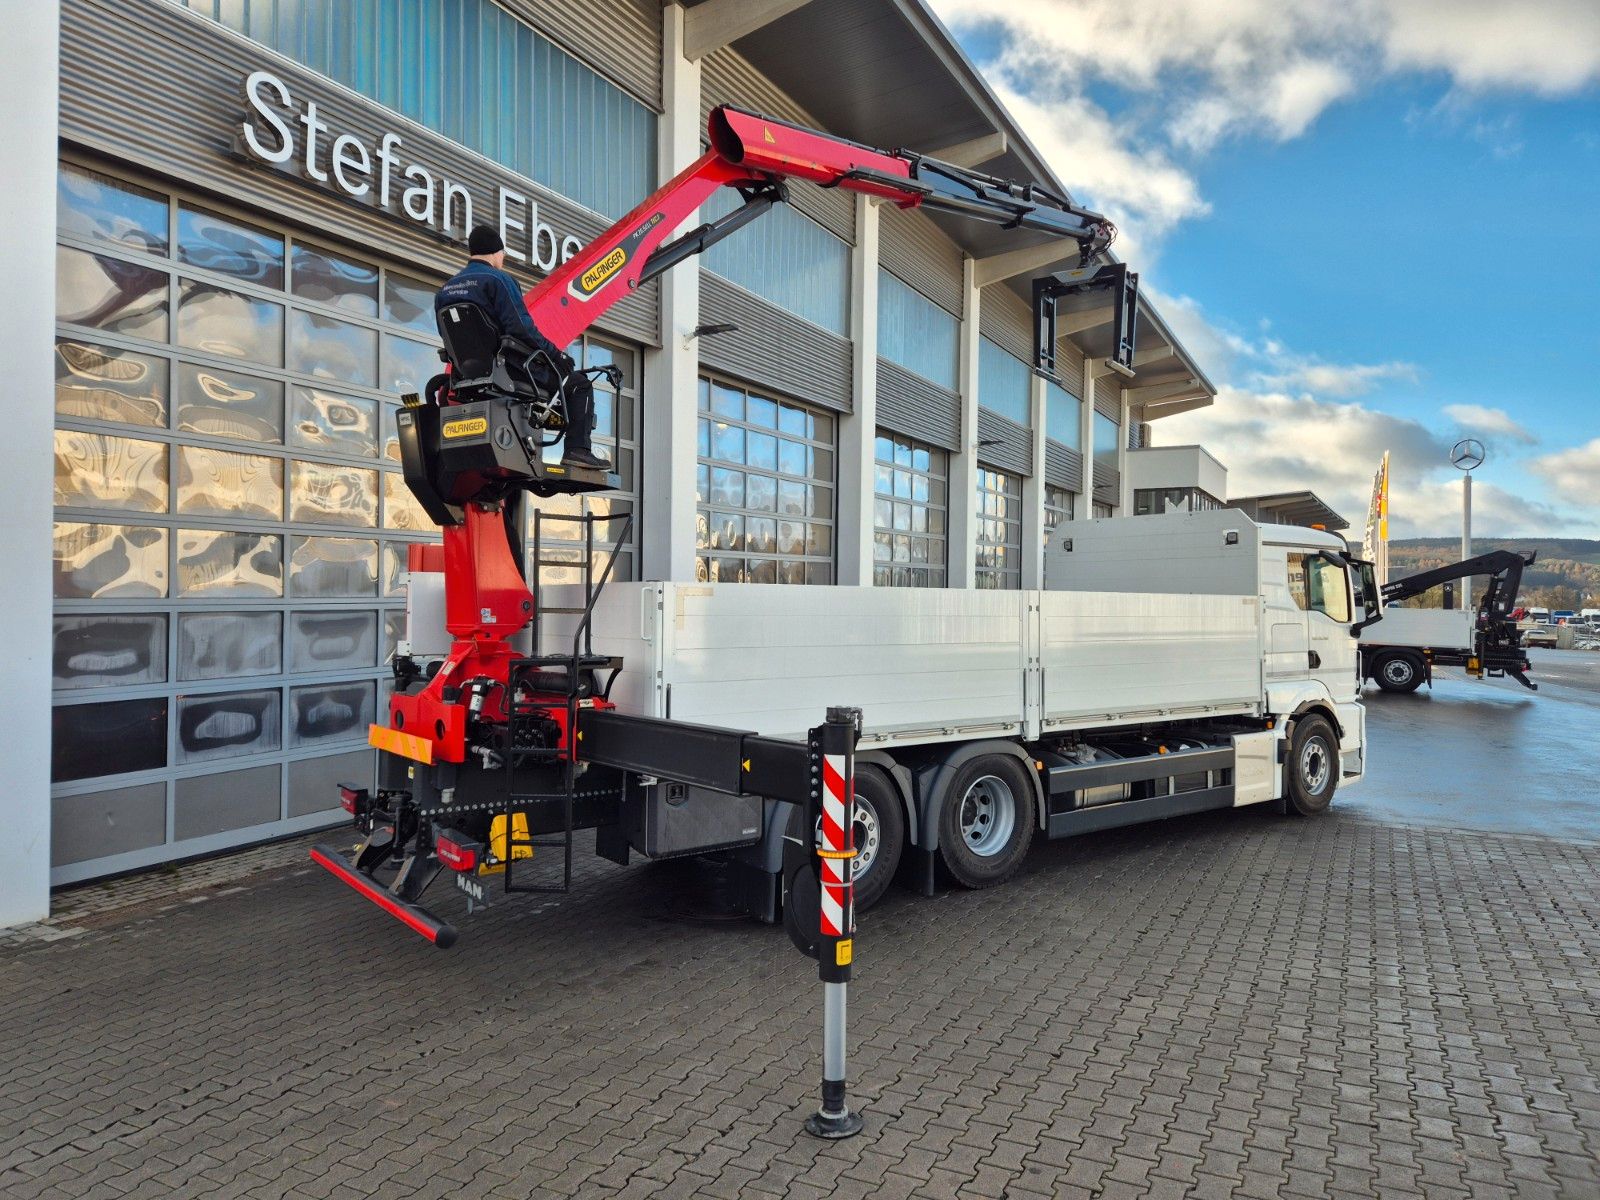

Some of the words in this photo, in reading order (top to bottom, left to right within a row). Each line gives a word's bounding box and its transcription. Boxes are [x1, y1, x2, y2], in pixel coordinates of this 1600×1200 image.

[242, 71, 473, 241] Stefan
[584, 251, 623, 287] PALFINGER
[445, 421, 485, 435] PALFINGER
[456, 873, 483, 900] MAN
